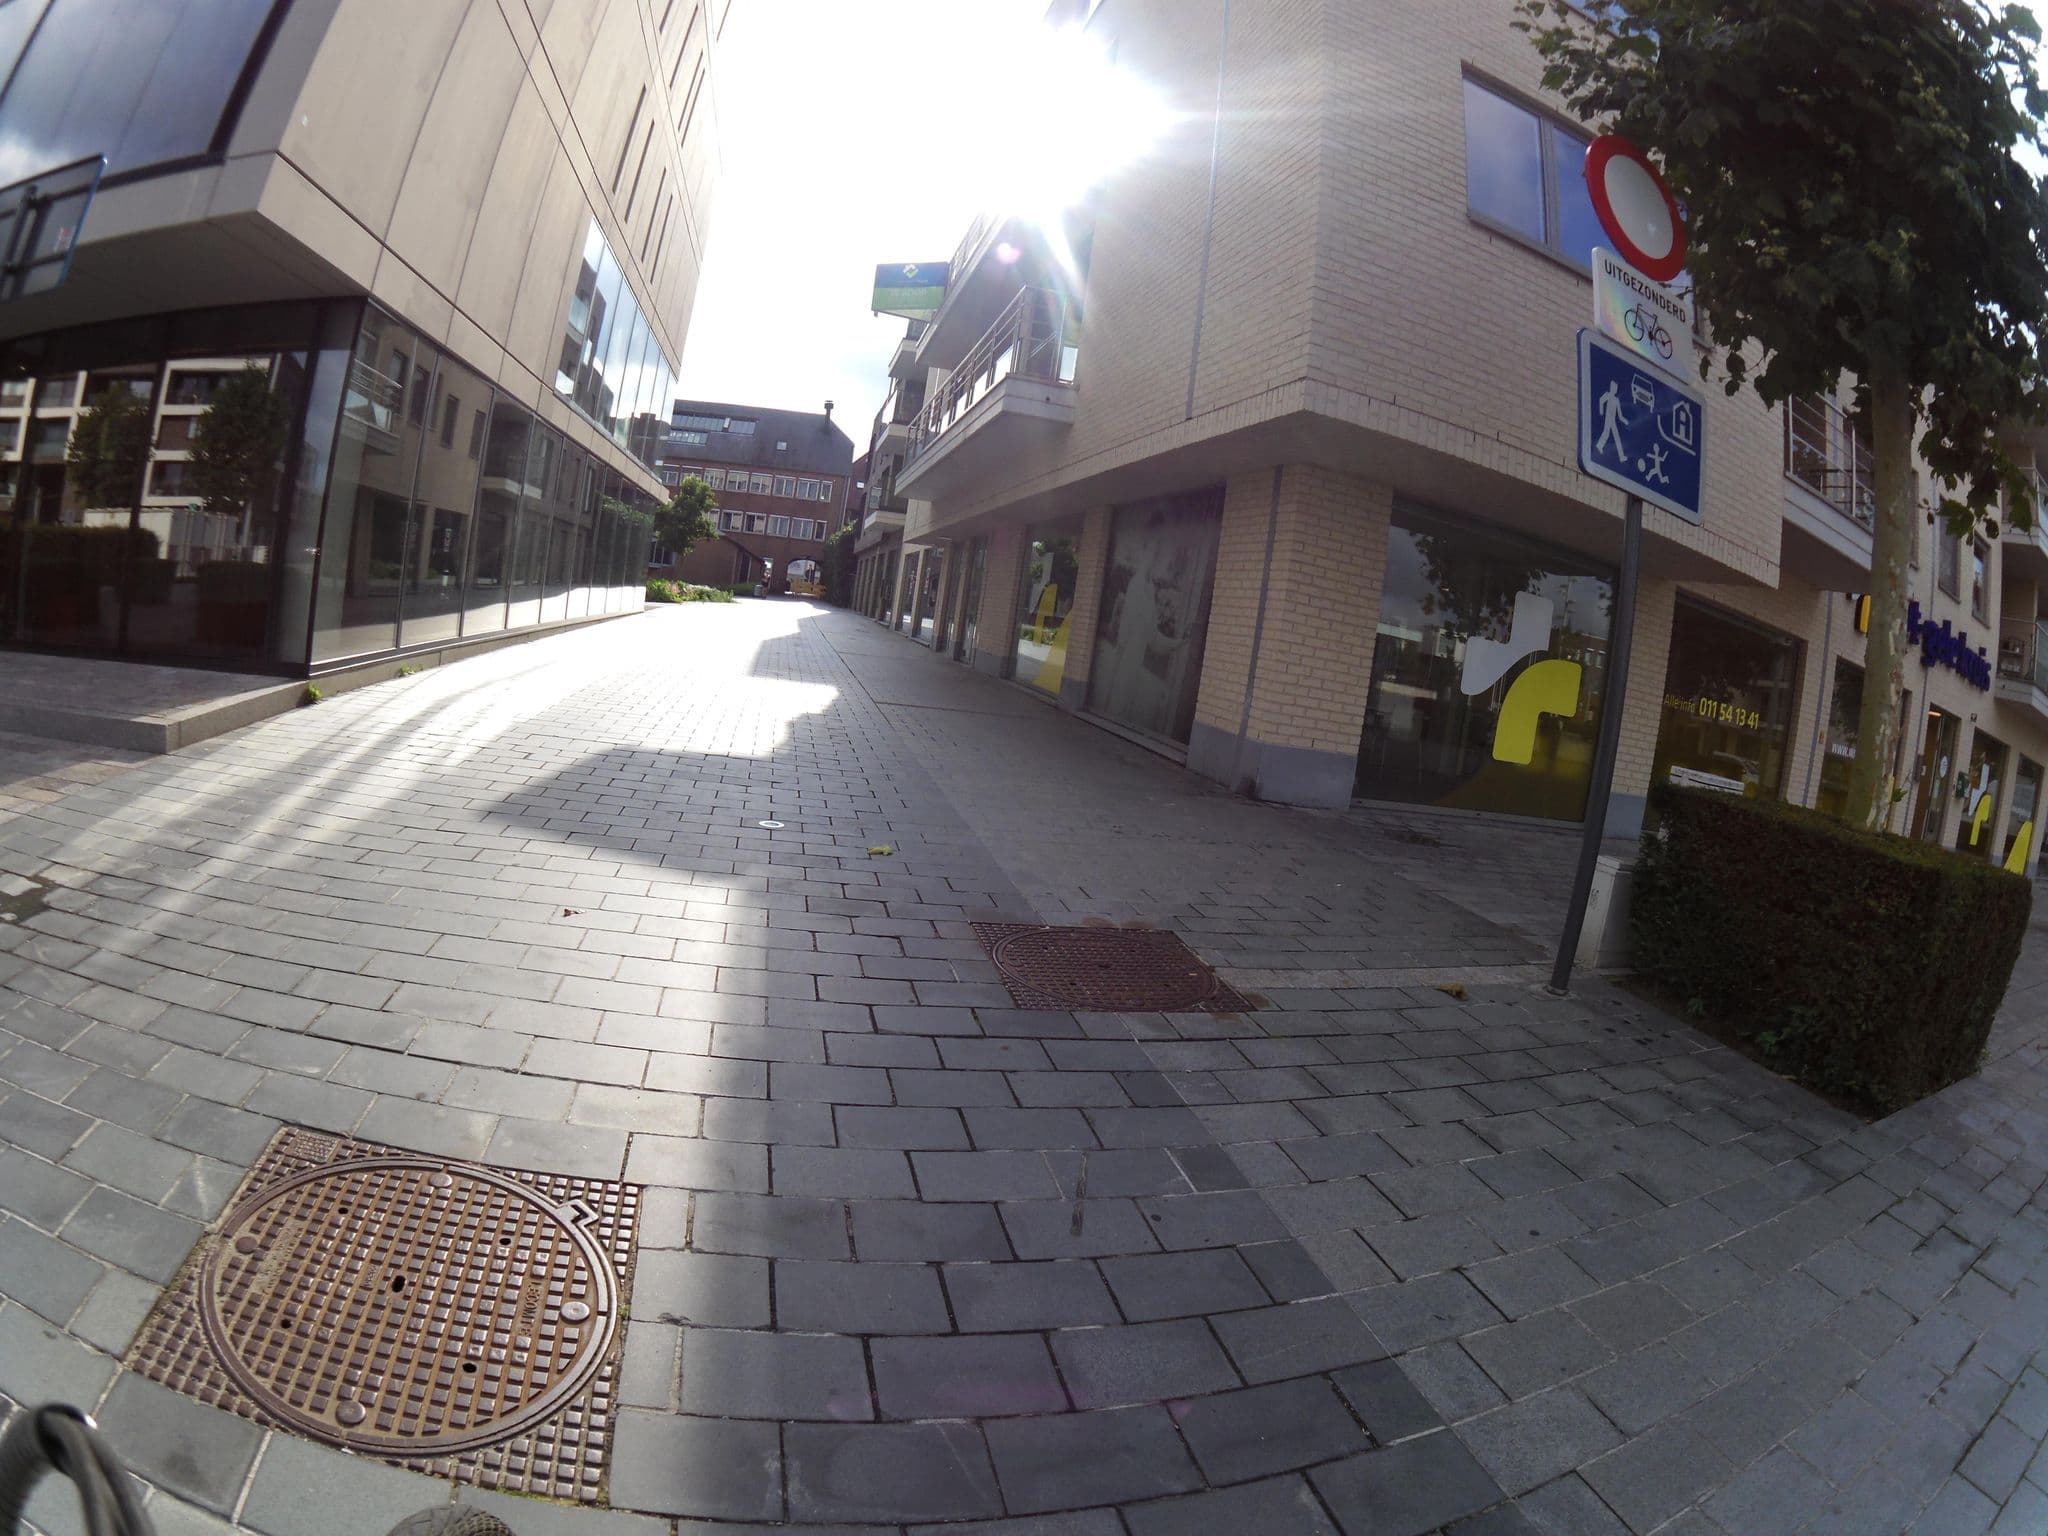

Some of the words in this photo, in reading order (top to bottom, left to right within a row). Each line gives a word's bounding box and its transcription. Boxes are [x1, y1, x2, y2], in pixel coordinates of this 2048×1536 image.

[1604, 259, 1686, 323] UITGEZONDERD
[1699, 697, 1718, 718] 011
[1719, 703, 1733, 723] 54
[1735, 708, 1746, 726] 13
[1748, 711, 1760, 730] 41
